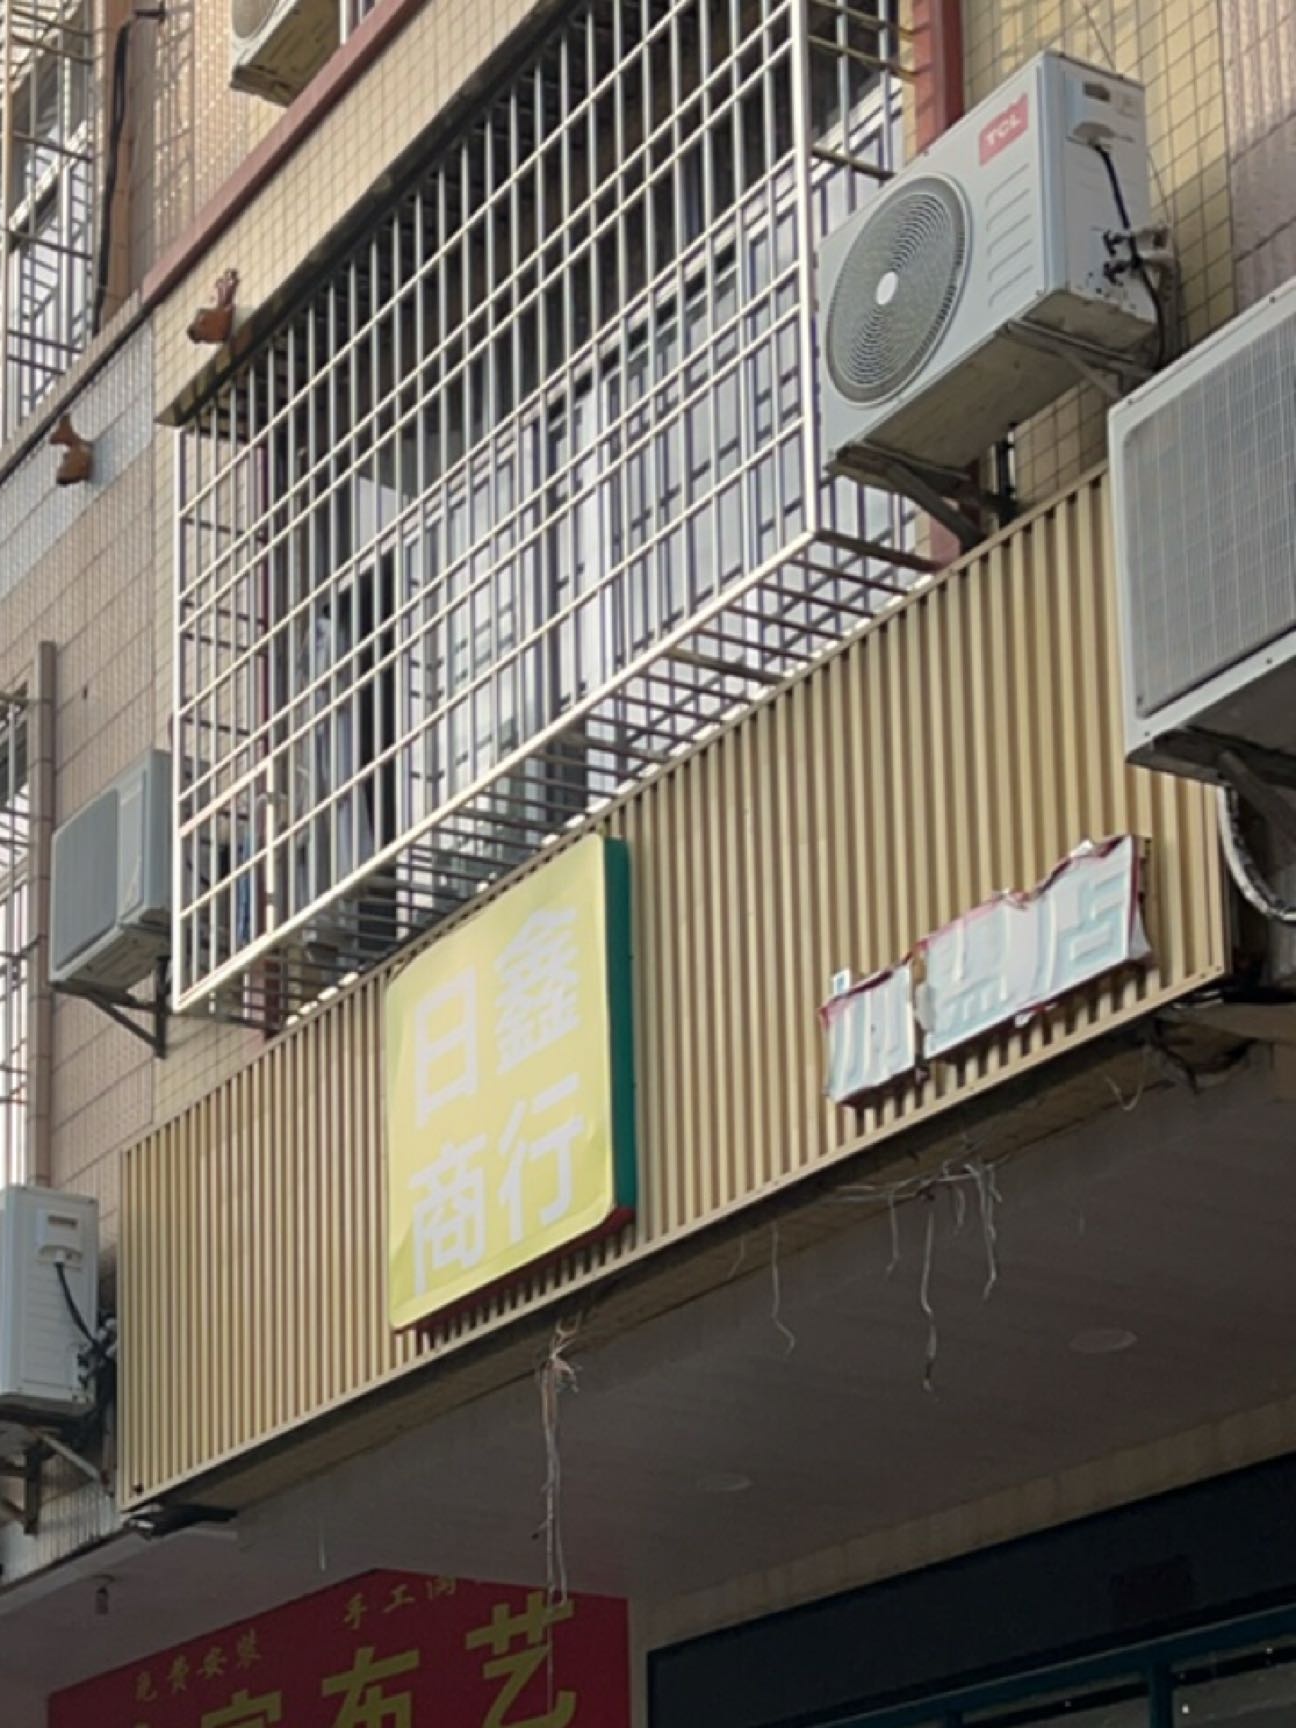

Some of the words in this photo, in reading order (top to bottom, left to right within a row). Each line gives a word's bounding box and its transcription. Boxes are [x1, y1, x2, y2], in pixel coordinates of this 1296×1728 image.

[985, 115, 1021, 147] TCL
[413, 905, 583, 1127] 日鑫
[409, 1071, 585, 1298] 商行
